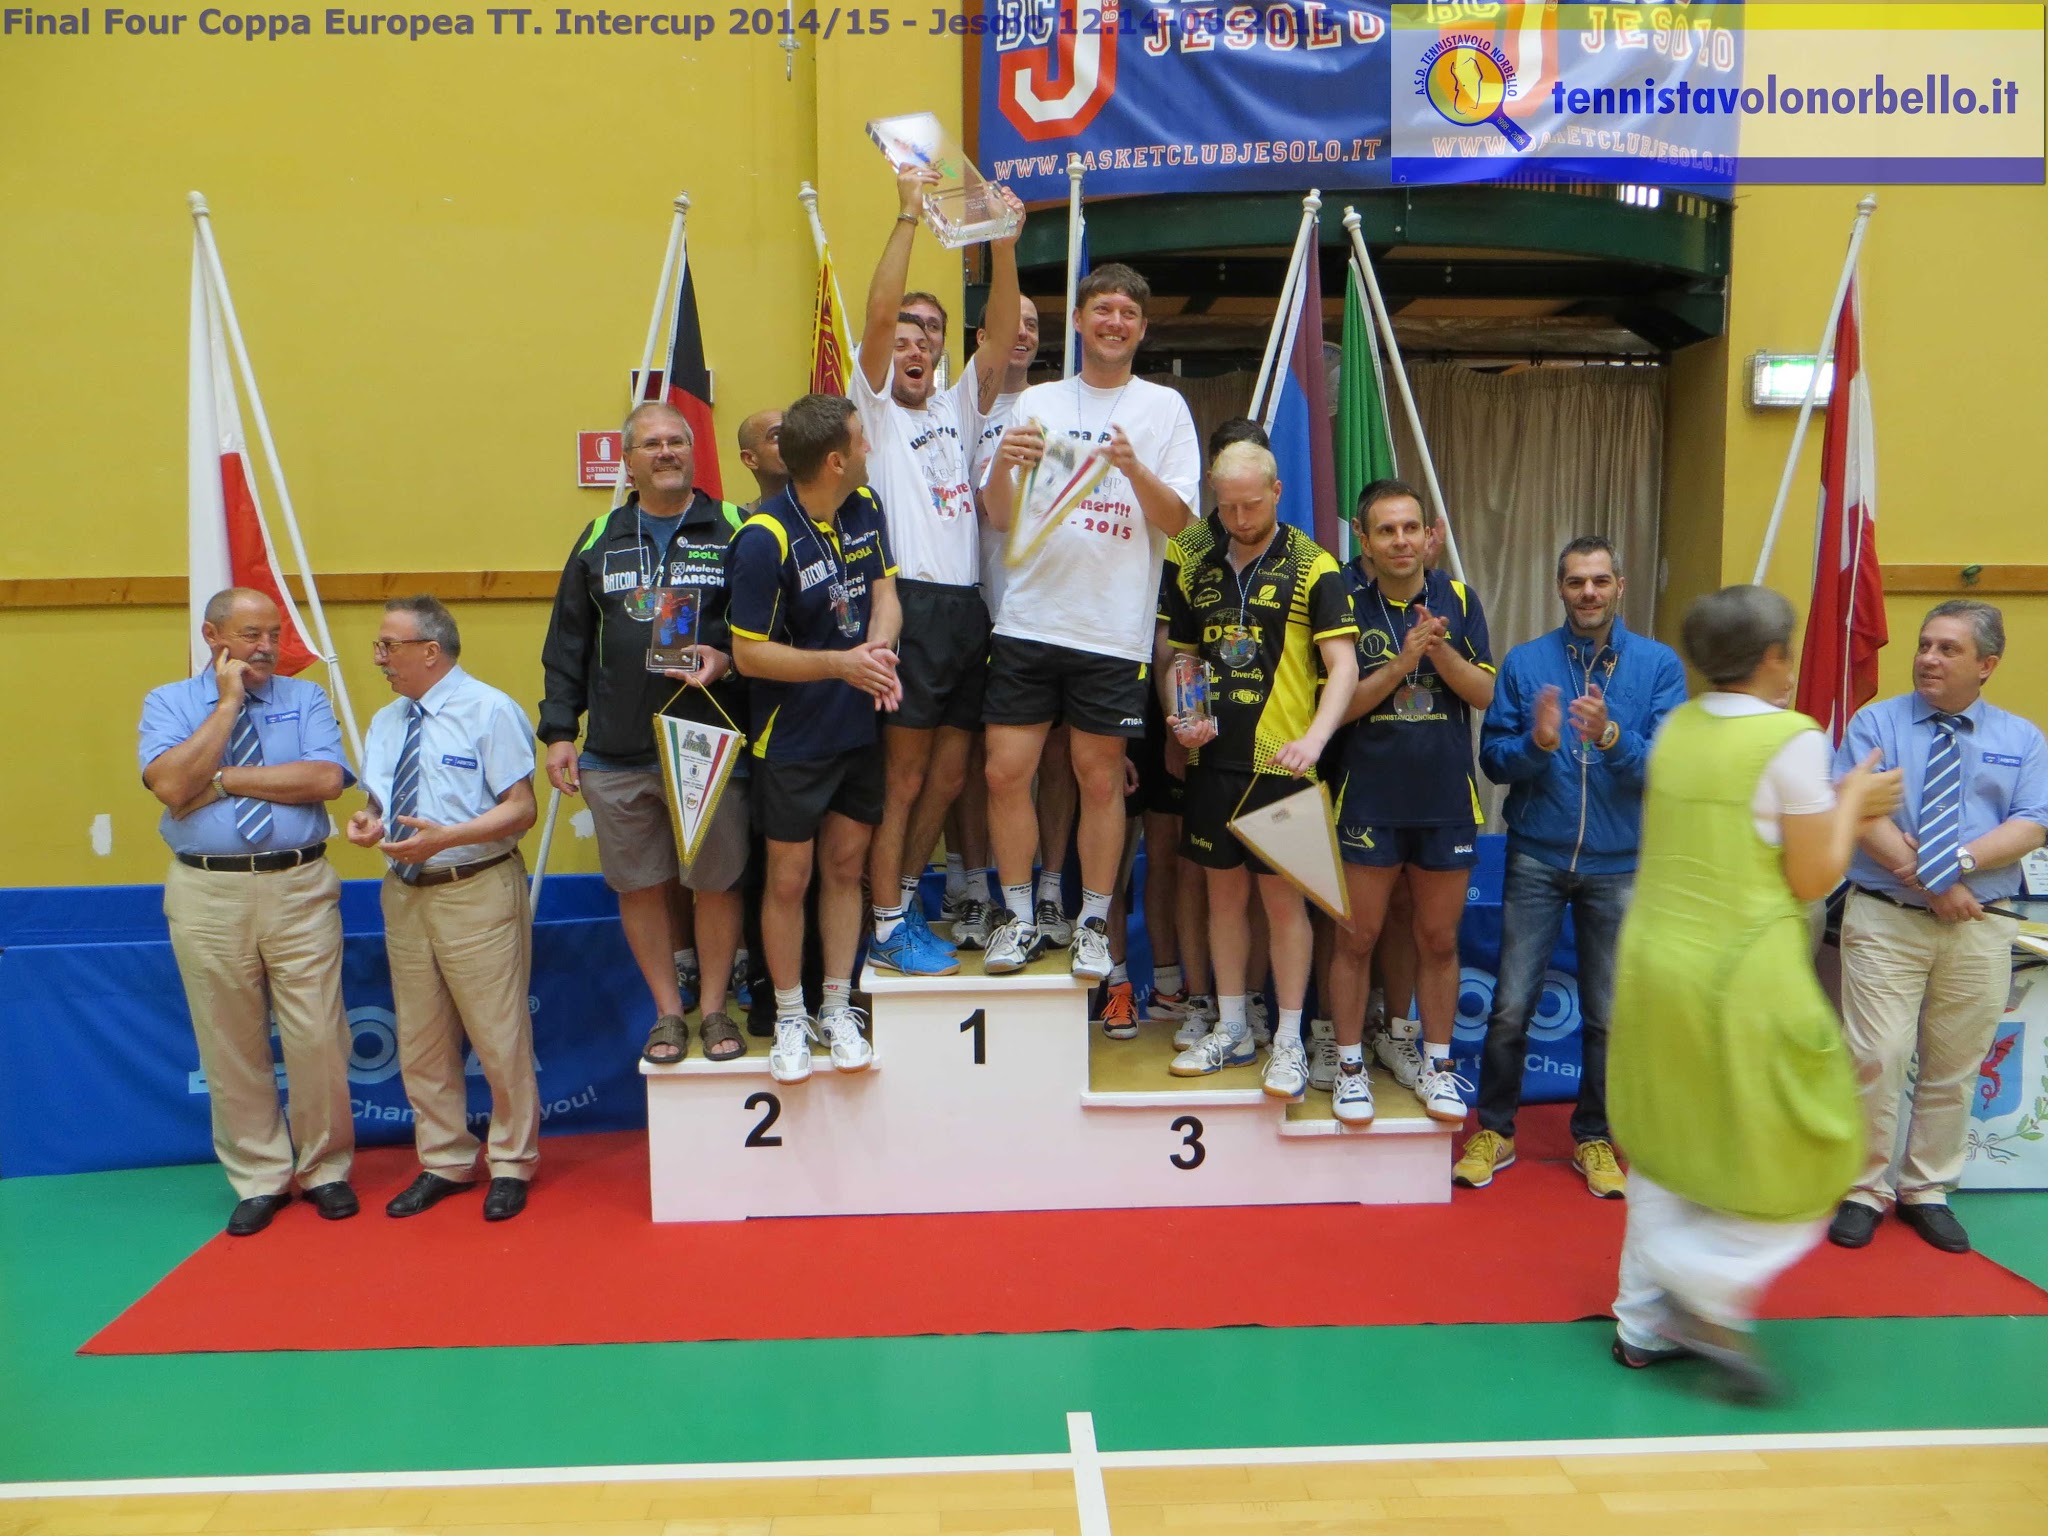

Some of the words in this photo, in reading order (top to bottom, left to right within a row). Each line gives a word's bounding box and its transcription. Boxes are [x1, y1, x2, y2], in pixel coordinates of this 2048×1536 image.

[1143, 2, 1385, 56] JESOLO
[1084, 517, 1132, 540] 2015
[688, 550, 719, 560] JOOLA
[670, 574, 725, 587] MARSCH
[685, 564, 725, 575] Malerei
[1231, 669, 1264, 682] Diversey
[1119, 717, 1144, 726] STIGA
[958, 1008, 986, 1065] 1
[540, 1085, 598, 1121] you!
[743, 1091, 783, 1148] 2
[1169, 1115, 1206, 1171] 3
